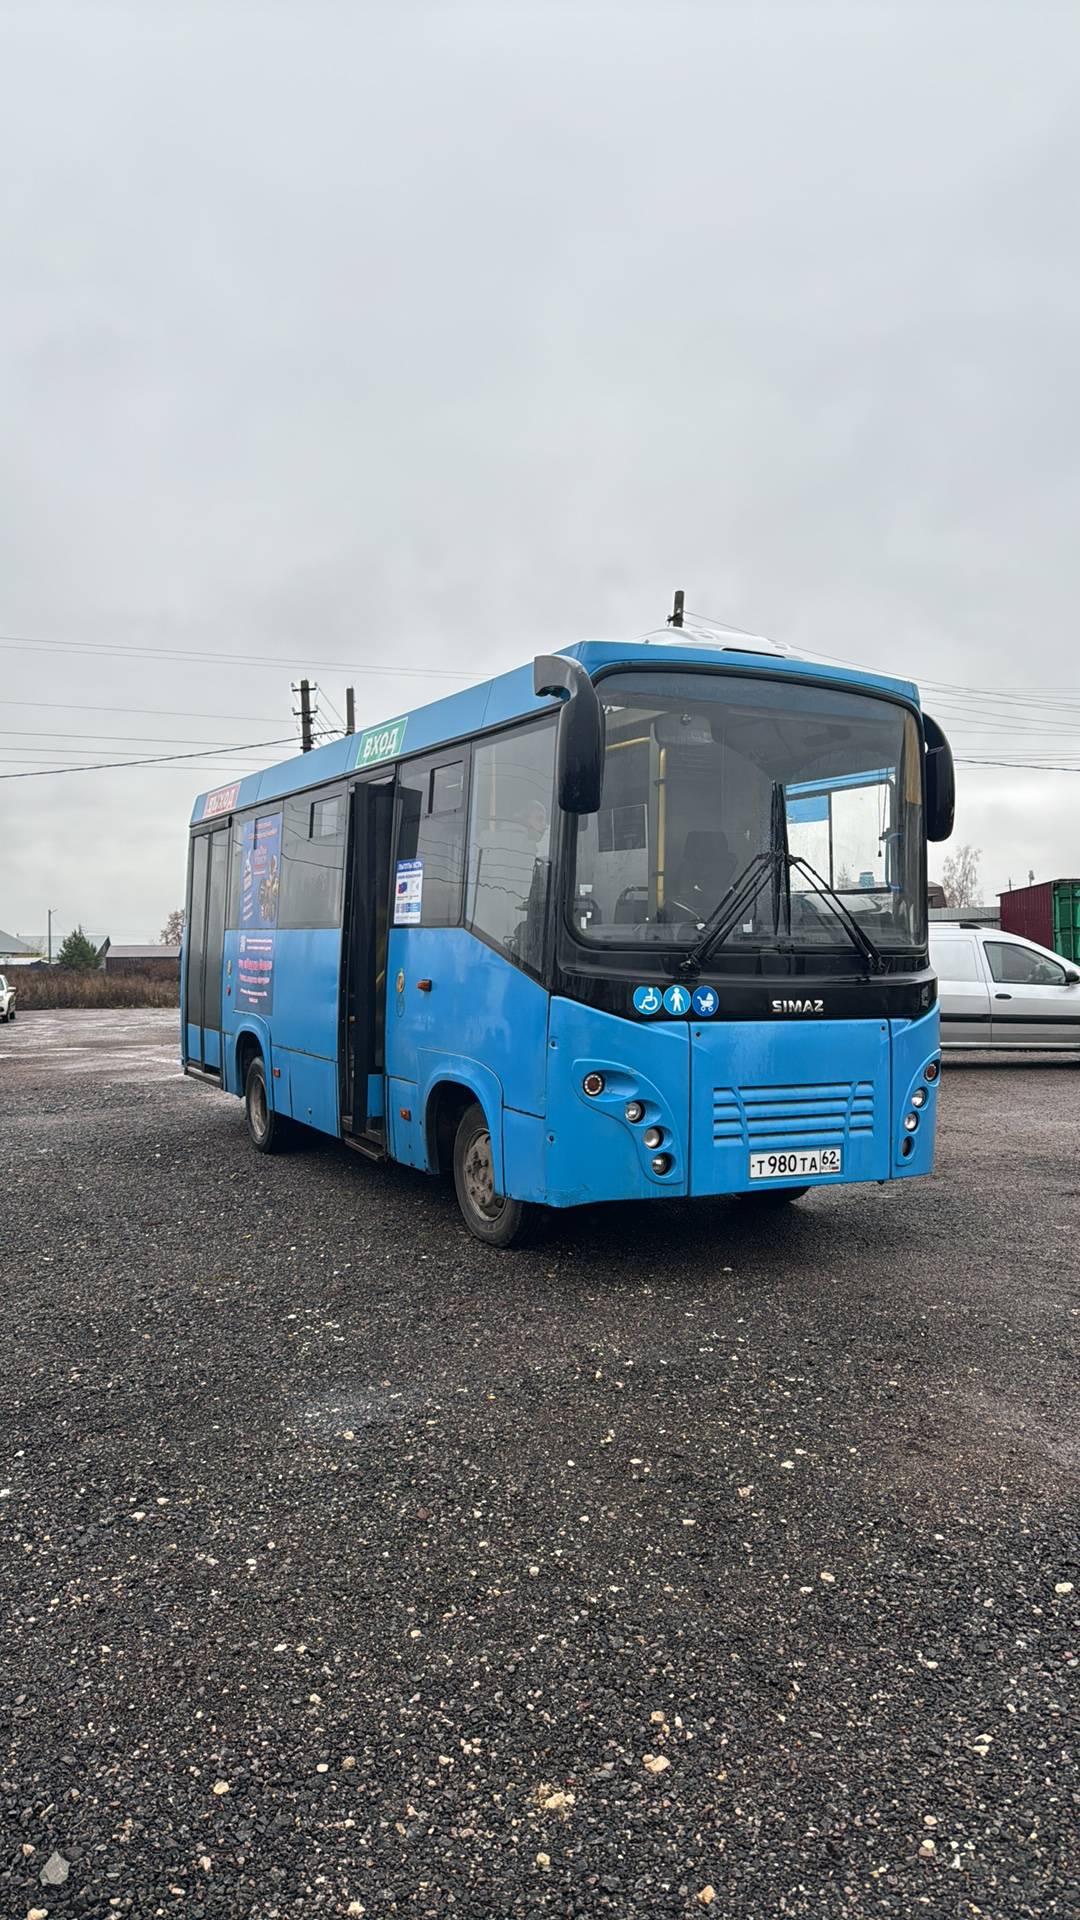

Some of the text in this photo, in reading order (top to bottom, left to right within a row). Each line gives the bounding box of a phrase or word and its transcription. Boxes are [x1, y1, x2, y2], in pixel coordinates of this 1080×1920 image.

[362, 727, 399, 759] ВХОД
[771, 999, 824, 1013] SIMAZ
[821, 1150, 837, 1165] 62
